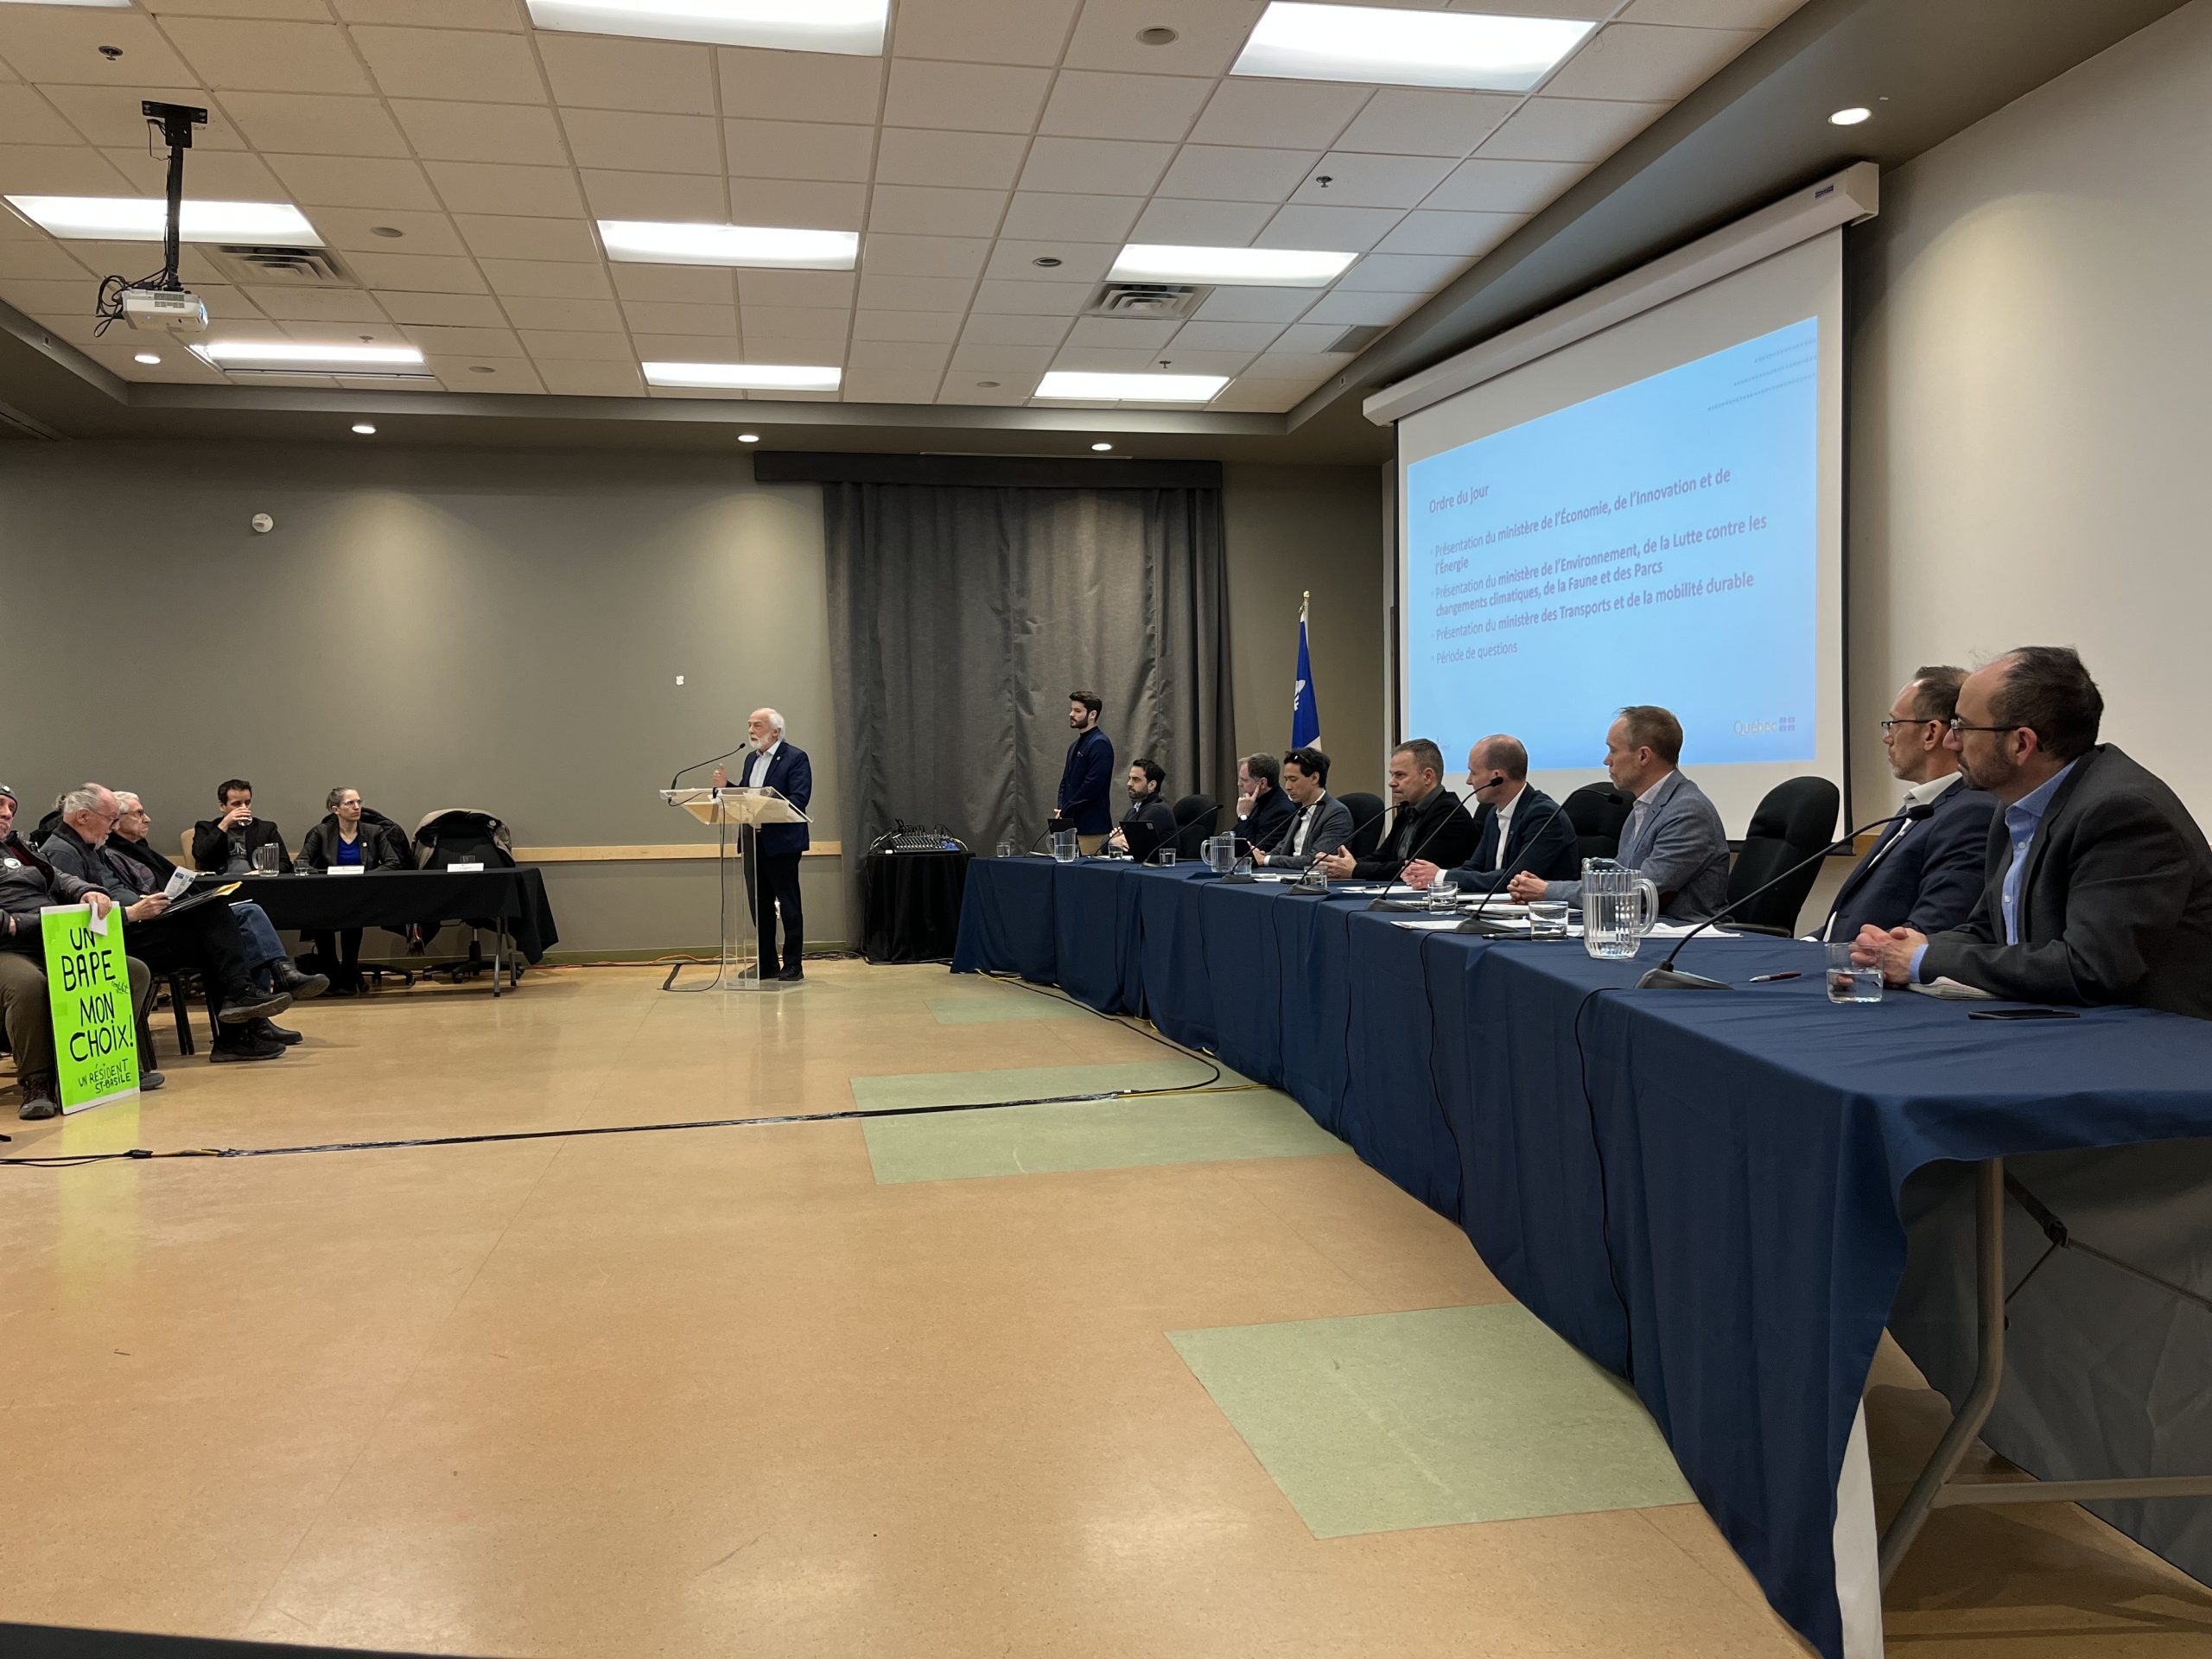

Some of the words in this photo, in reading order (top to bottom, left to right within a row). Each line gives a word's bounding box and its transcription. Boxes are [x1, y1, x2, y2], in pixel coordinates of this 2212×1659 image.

[1429, 495, 1454, 513] Ordre
[1457, 490, 1468, 505] du
[1470, 486, 1489, 505] jour
[1435, 535, 1484, 556] Présentation
[1485, 531, 1496, 544] du
[1497, 520, 1539, 541] ministère
[1541, 516, 1553, 531] de
[1614, 496, 1627, 511] de
[1700, 473, 1713, 488] et
[1715, 467, 1731, 484] de
[1436, 578, 1484, 599] Présentation
[1485, 575, 1496, 588] du
[1498, 567, 1539, 586] ministère
[1541, 562, 1553, 576] de
[1643, 539, 1656, 554] de
[1660, 536, 1669, 550] la
[1673, 530, 1702, 548] Lutte
[1706, 520, 1745, 540] contre
[1749, 515, 1767, 531] les
[1436, 596, 1487, 617] changements
[1490, 586, 1541, 607] climatiques,
[1543, 582, 1554, 595] de
[1557, 579, 1566, 593] la
[1568, 575, 1598, 591] Faune
[1600, 570, 1611, 584] et
[1613, 567, 1631, 582] des
[1634, 561, 1662, 577] Parcs
[1436, 622, 1484, 641] Présentation
[1485, 619, 1496, 632] du
[1498, 612, 1539, 630] ministère
[1541, 608, 1557, 622] des
[1559, 597, 1611, 619] Transports
[1613, 595, 1624, 610] et
[1627, 593, 1640, 607] de
[1643, 589, 1653, 605] la
[1656, 580, 1703, 603] mobilité
[1707, 571, 1753, 594] durable
[1436, 647, 1464, 664] Période
[1465, 646, 1476, 659] de
[1478, 642, 1517, 660] questions
[1733, 719, 1777, 737] Québec
[70, 927, 95, 950] UN
[61, 950, 116, 991] BAPE
[80, 992, 115, 1027] MON
[79, 1074, 87, 1088] UN
